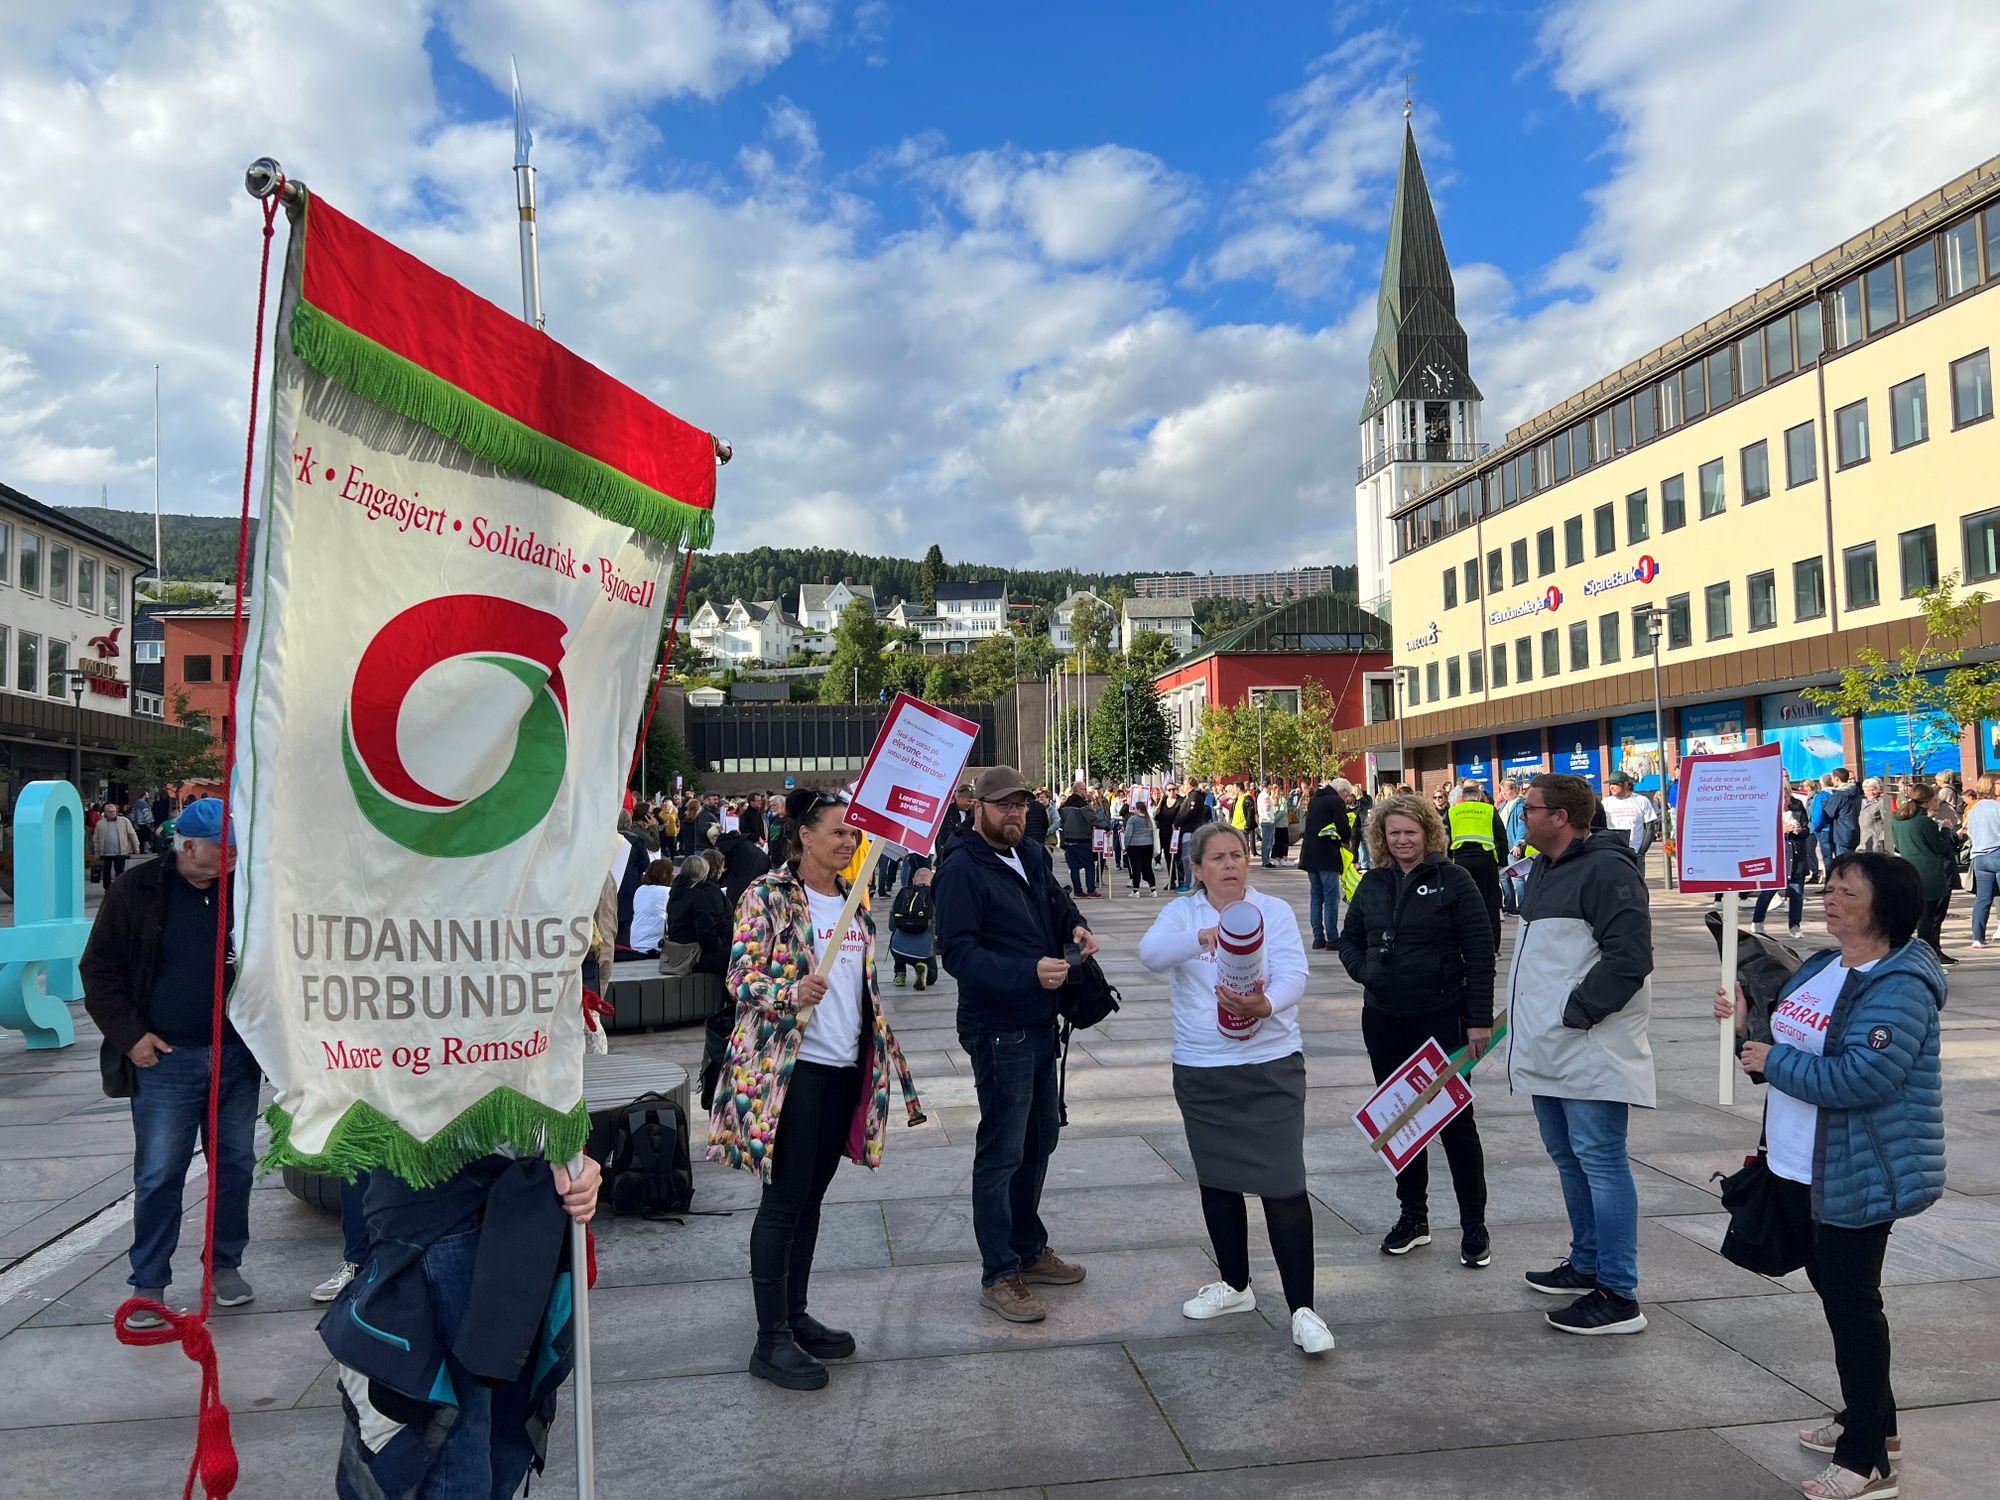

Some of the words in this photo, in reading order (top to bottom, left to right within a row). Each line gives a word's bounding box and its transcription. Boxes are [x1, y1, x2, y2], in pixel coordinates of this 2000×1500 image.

[294, 446, 319, 485] rk
[339, 464, 448, 536] Engasjert
[468, 516, 577, 580] Solidarisk
[1584, 567, 1637, 596] SpareBank
[898, 793, 931, 809] Lærarane
[899, 802, 926, 814] streikar
[292, 912, 590, 962] UTDANNINGS
[302, 969, 577, 1023] FORBUNDET
[321, 1039, 382, 1070] Møre
[392, 1045, 431, 1076] og
[440, 1030, 548, 1066] Romsda
